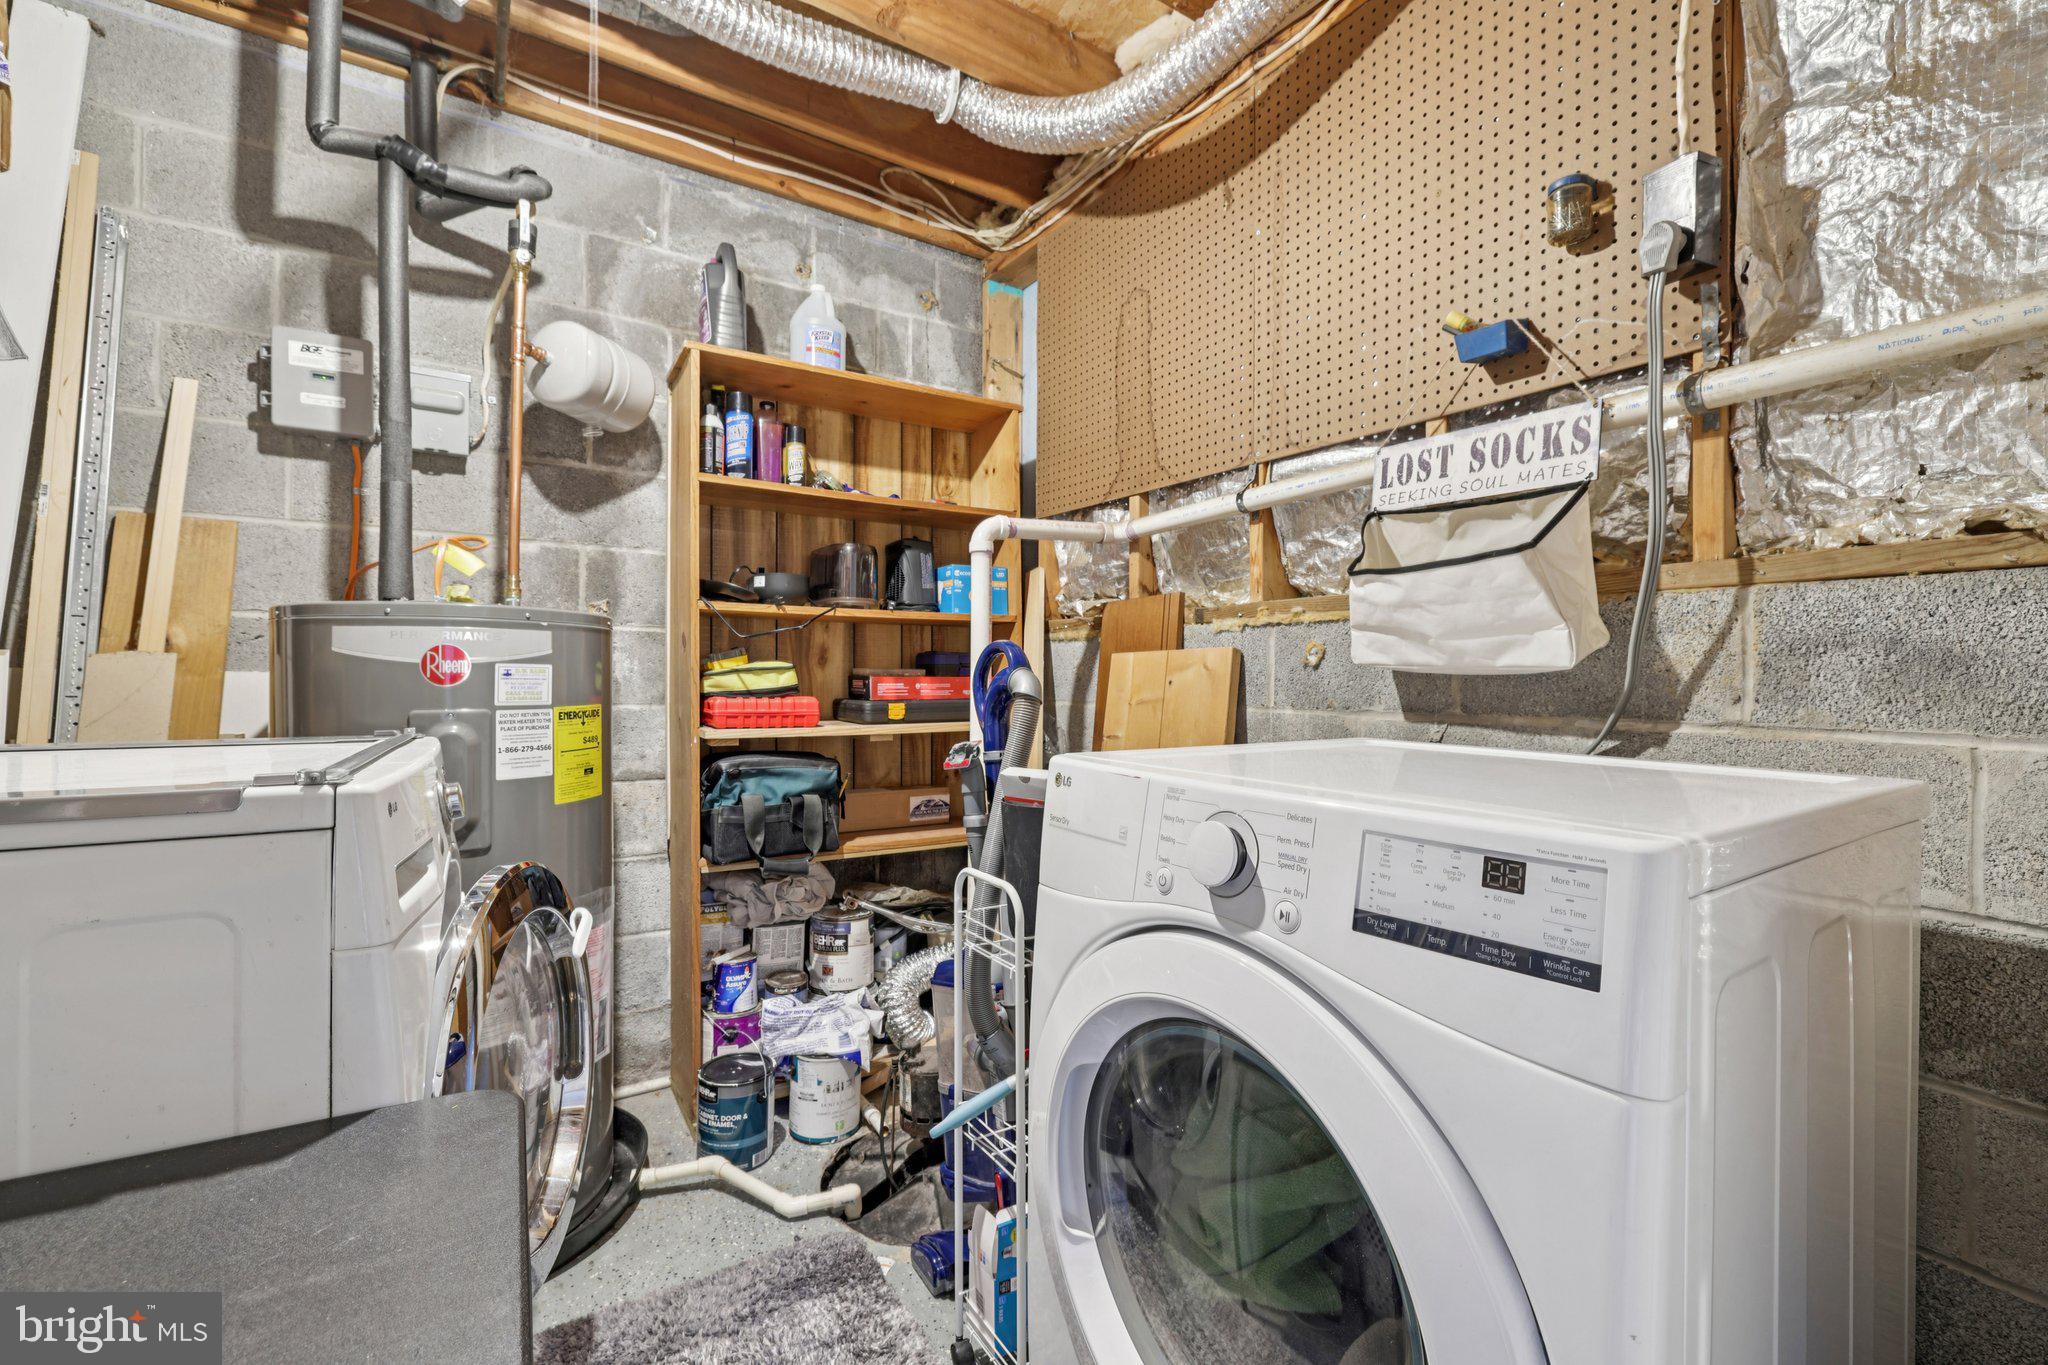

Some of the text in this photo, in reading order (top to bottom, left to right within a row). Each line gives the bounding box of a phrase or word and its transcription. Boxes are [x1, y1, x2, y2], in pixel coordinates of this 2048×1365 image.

[300, 344, 324, 354] BGE
[1380, 414, 1592, 490] LOST SOCKS
[1378, 460, 1588, 507] SEEKING SOUL MATES
[390, 630, 504, 641] PERORMANCE
[427, 644, 470, 680] Rheem
[497, 744, 552, 753] 1-866-279-4566
[1063, 775, 1073, 787] LG
[1286, 812, 1313, 824] Delicates
[1294, 838, 1311, 849] Press
[1278, 852, 1297, 860] MANUAL
[1277, 860, 1307, 874] Speed Dry
[1434, 883, 1448, 892] High
[1551, 875, 1591, 890] More Time
[1293, 889, 1304, 899] Dry
[1377, 889, 1397, 897] Normal
[1432, 900, 1455, 911] Medium
[1493, 895, 1516, 905] 60 min
[1491, 913, 1501, 921] 40
[1550, 906, 1587, 920] Less Time
[1367, 916, 1397, 930] Dry Level
[814, 934, 835, 946] BEHR
[1427, 934, 1447, 947] Temp.
[1543, 932, 1591, 949] Energy Saver
[1480, 943, 1516, 960] Time Dry
[1492, 955, 1501, 964] Dry
[1502, 958, 1517, 968] Signal
[1543, 959, 1591, 977] Wrinkle Care
[1569, 974, 1583, 983] Lock
